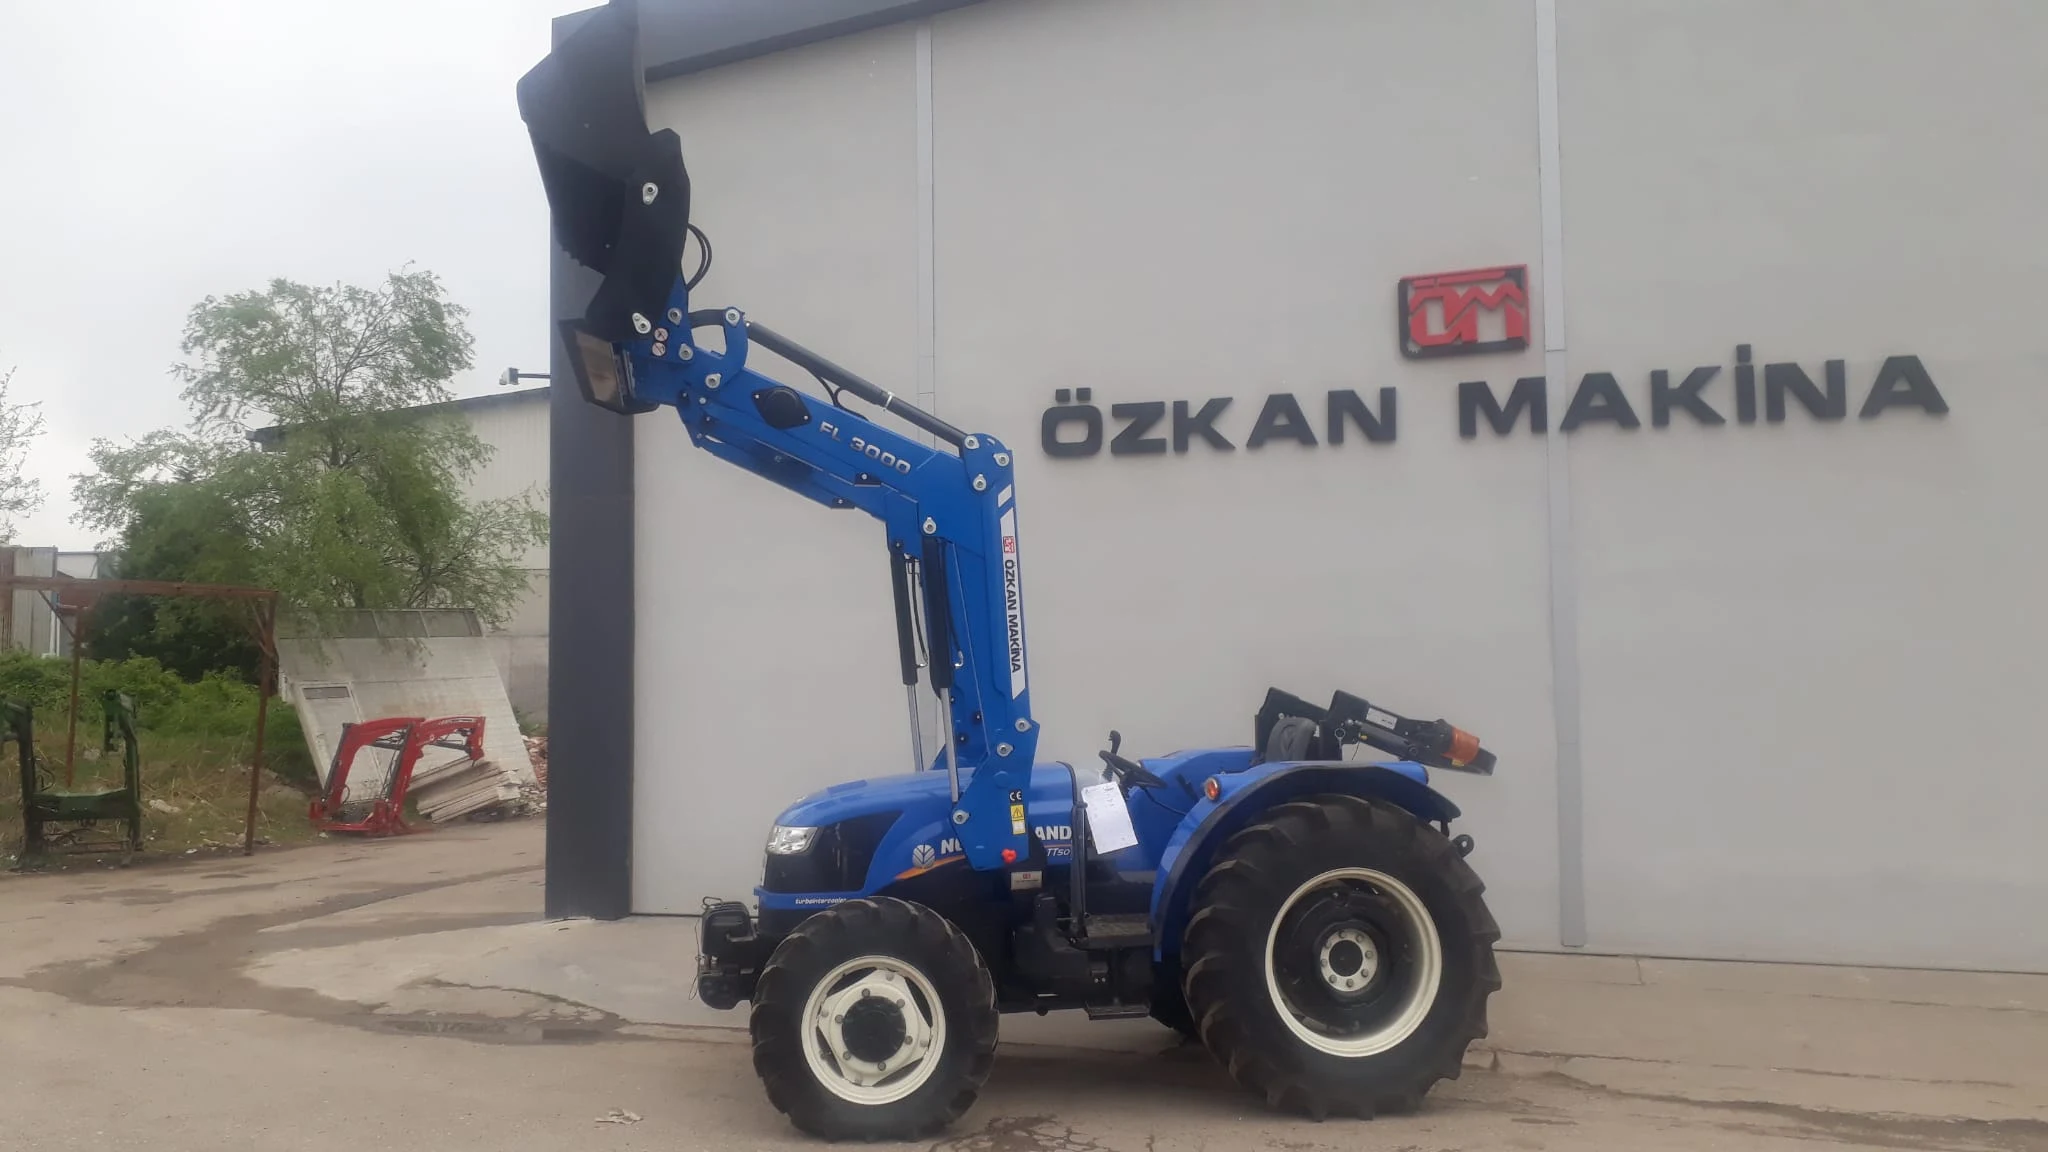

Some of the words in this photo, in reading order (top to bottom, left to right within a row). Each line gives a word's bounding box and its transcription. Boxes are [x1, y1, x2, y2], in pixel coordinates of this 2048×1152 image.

[1041, 387, 1398, 460] ÖZKAN
[1457, 344, 1949, 440] MAKİNA
[820, 421, 841, 442] FL
[850, 436, 912, 475] 3000
[1004, 558, 1017, 611] ÖZKAN
[1008, 613, 1022, 673] MAKİNA
